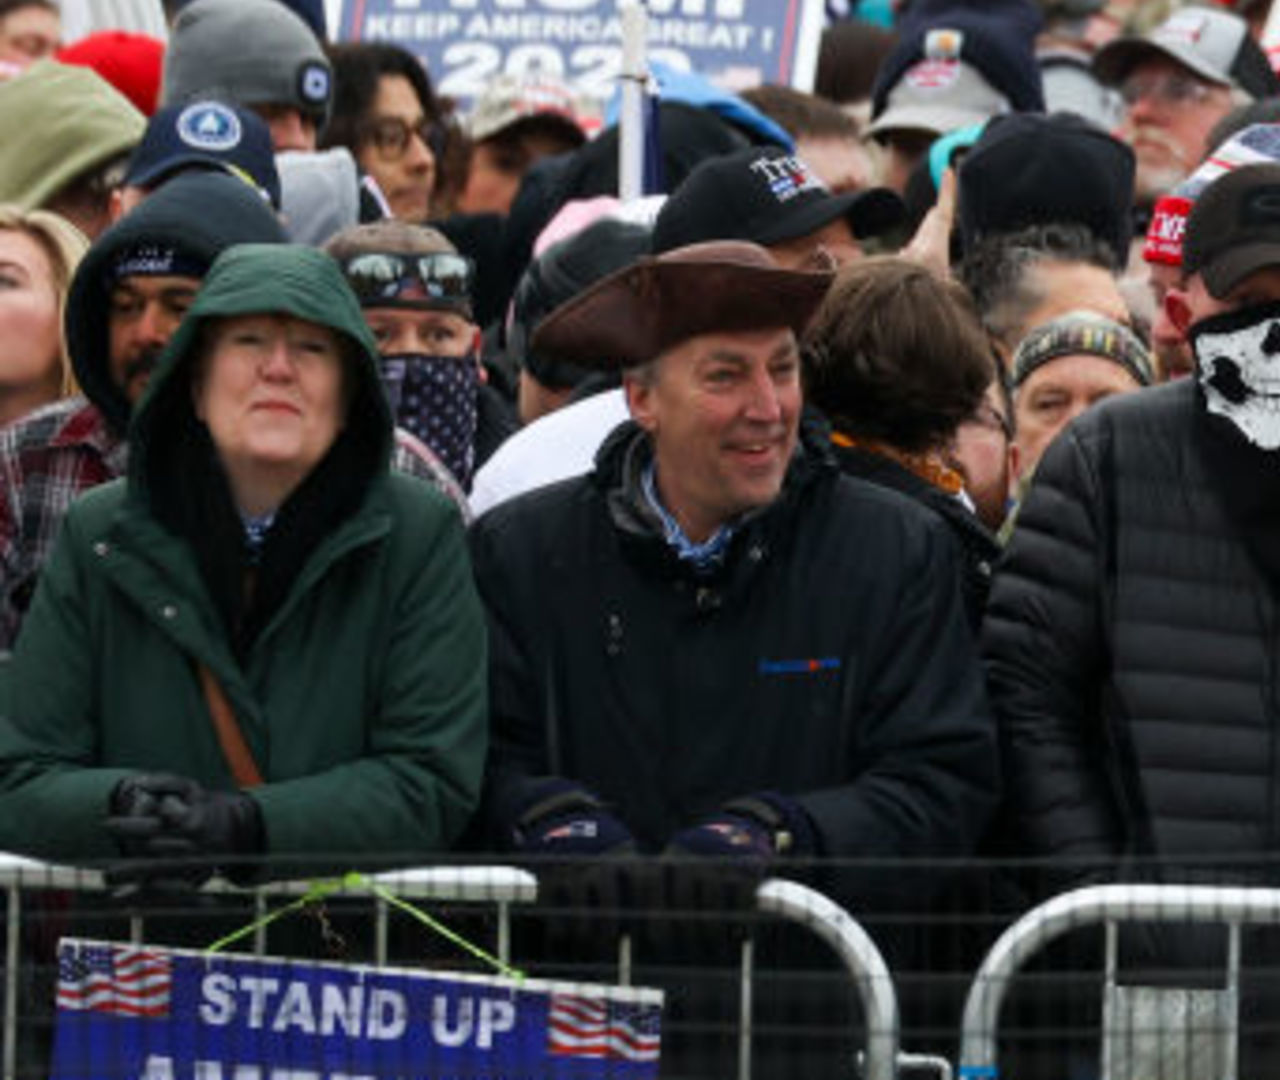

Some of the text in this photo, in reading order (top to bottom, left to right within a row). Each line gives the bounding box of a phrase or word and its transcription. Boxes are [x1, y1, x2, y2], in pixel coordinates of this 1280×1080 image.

[366, 12, 460, 41] KEEP
[465, 14, 624, 44] AMERICA
[200, 973, 517, 1049] STAND UP
